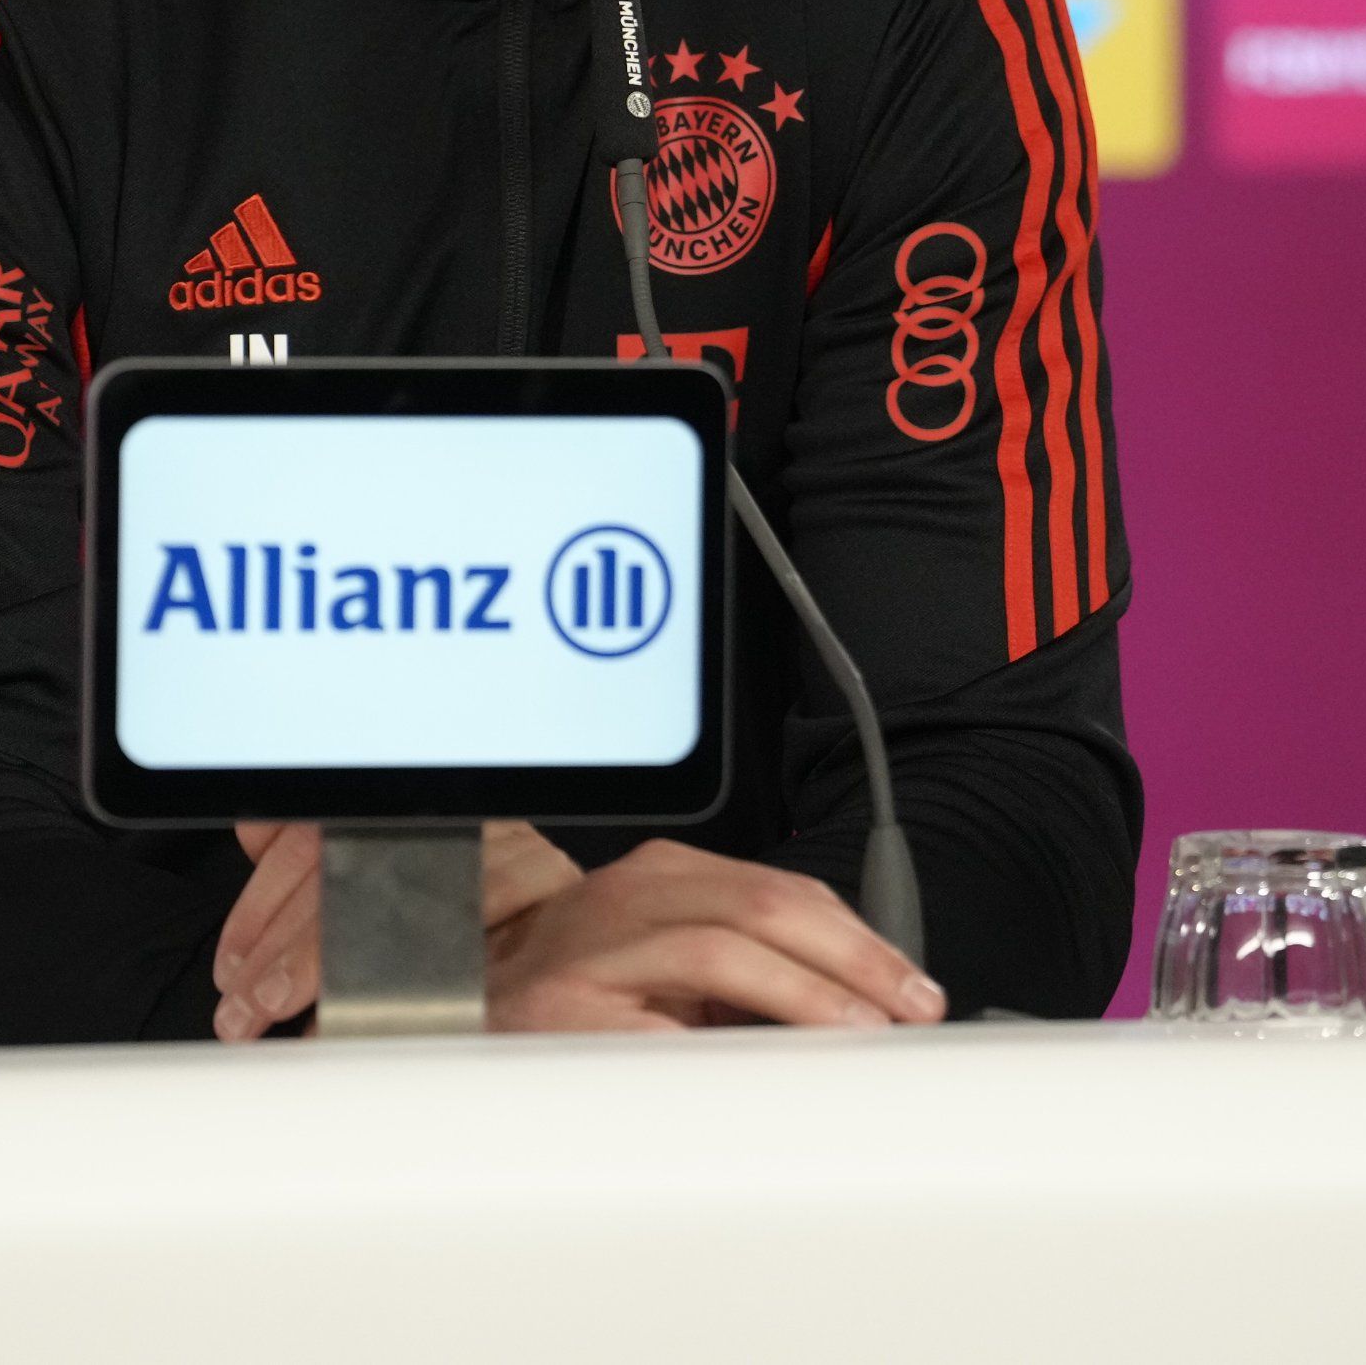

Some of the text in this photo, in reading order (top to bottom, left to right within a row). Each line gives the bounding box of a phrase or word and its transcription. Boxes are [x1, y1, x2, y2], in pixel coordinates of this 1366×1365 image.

[619, 0, 643, 86] MÜNCHEN
[656, 110, 759, 165] BAYERN
[649, 196, 762, 261] ÜNCHEN
[168, 269, 323, 313] adidas
[143, 542, 513, 635] Allianz
